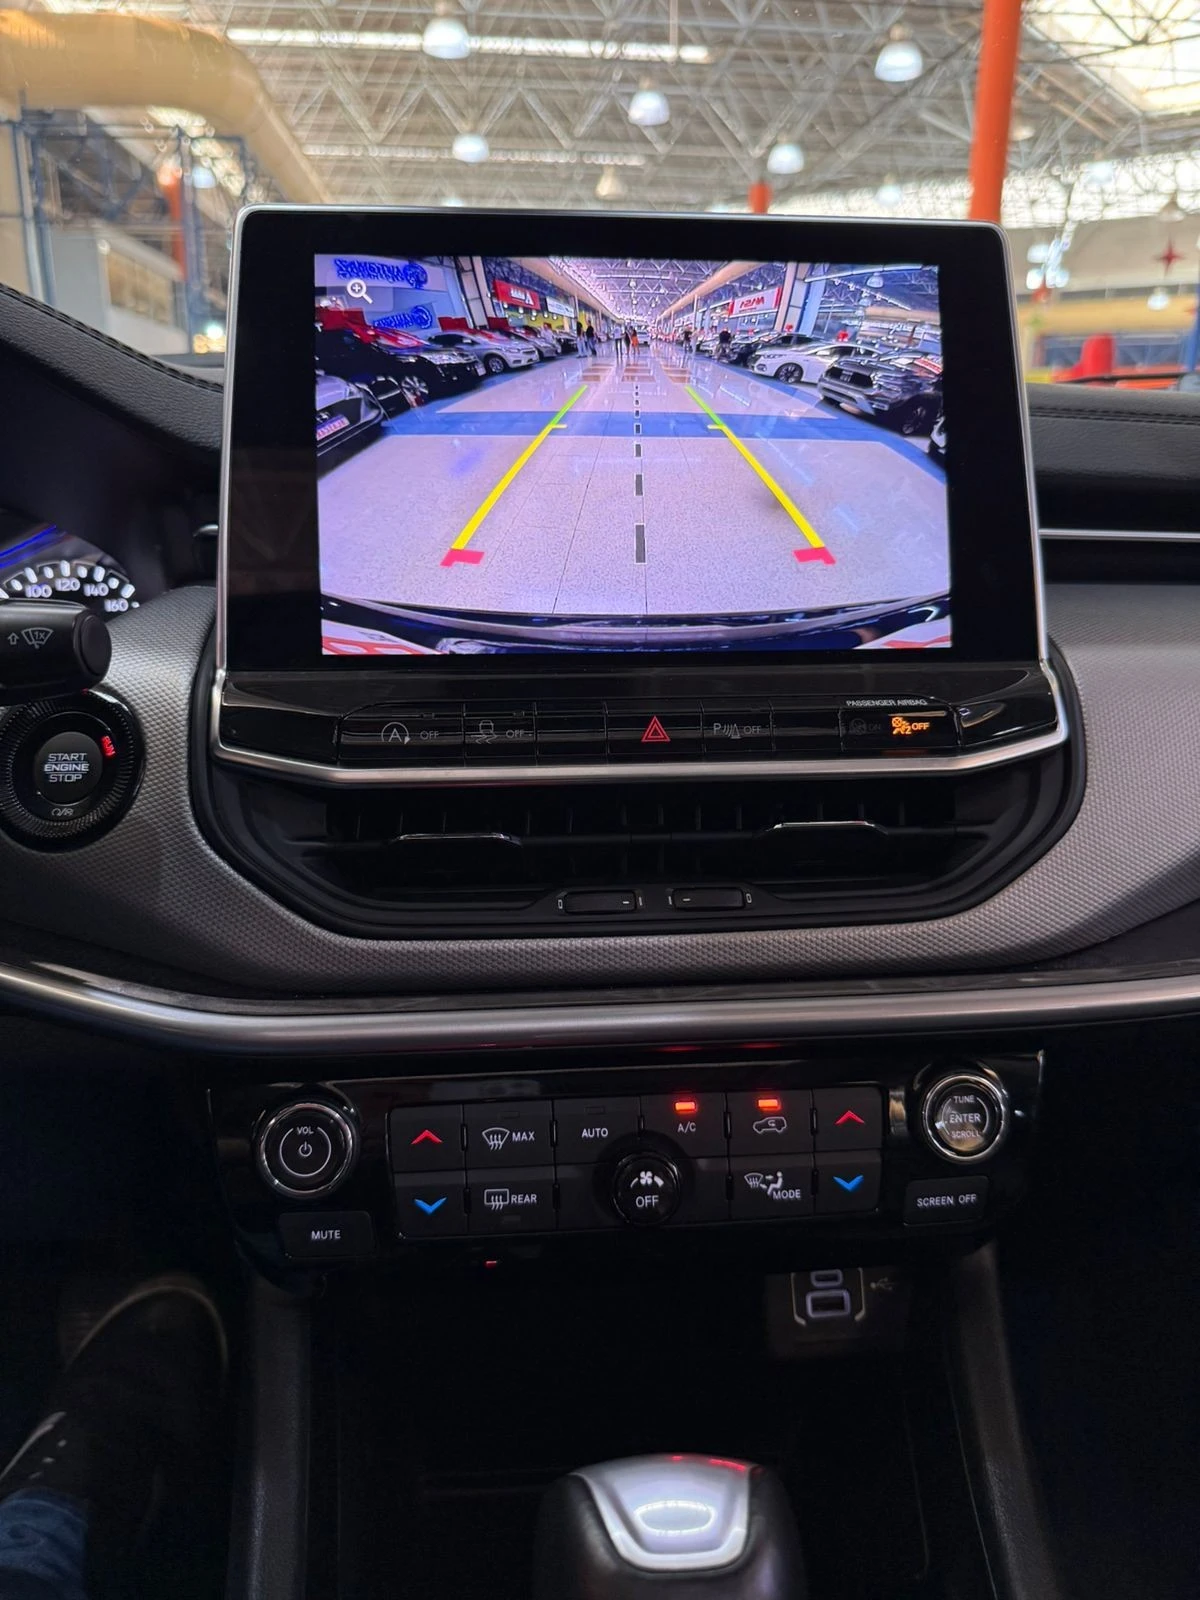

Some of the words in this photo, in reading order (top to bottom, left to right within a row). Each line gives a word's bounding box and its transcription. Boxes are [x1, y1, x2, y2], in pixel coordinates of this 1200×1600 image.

[55, 577, 80, 591] 120
[25, 584, 52, 598] 100
[83, 583, 109, 597] 140
[104, 598, 129, 612] 160
[714, 723, 721, 735] P
[743, 726, 761, 735] OFF
[911, 722, 930, 730] OFF
[420, 730, 438, 740] OFF
[506, 729, 524, 738] OFF
[103, 736, 116, 757] RUN
[48, 753, 87, 762] START
[49, 774, 82, 783] STOP
[954, 1095, 975, 1103] TUNE
[949, 1112, 981, 1124] ENTER
[297, 1126, 314, 1135] VOL
[677, 1122, 696, 1133] A/C
[512, 1132, 535, 1142] MAX
[581, 1128, 609, 1138] AUTO
[951, 1130, 980, 1139] SCROLL
[511, 1194, 537, 1204] REAR
[773, 1189, 801, 1200] MODE
[635, 1195, 659, 1208] OFF
[916, 1195, 954, 1207] SCREEN
[958, 1194, 976, 1203] OFF
[311, 1229, 341, 1240] MUTE
